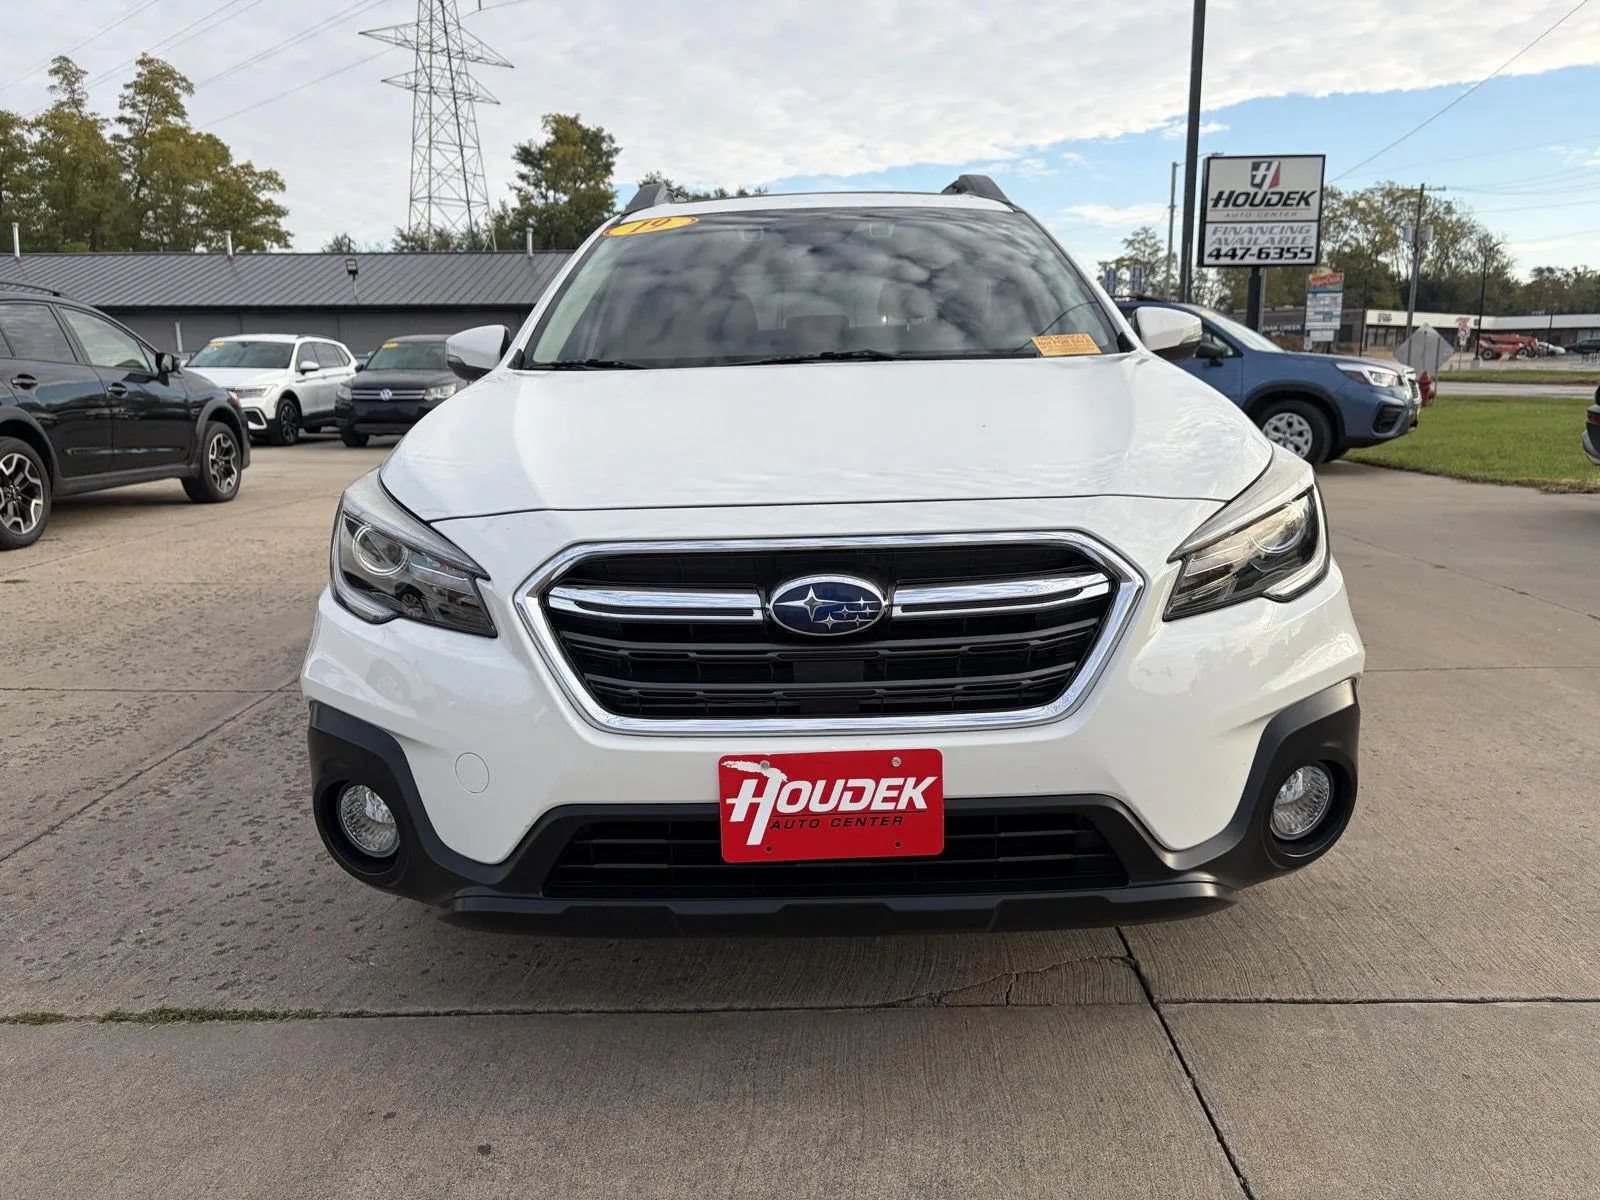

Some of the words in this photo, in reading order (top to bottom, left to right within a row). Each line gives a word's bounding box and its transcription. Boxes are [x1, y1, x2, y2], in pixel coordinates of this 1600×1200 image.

[1210, 190, 1317, 208] HOUDEK
[1211, 225, 1312, 236] FINANCING
[1209, 236, 1312, 247] AVAILABLE
[1207, 246, 1314, 260] 447-6355
[722, 762, 938, 845] HOUDEK
[770, 817, 820, 830] AUTO
[830, 815, 904, 828] CENTER
